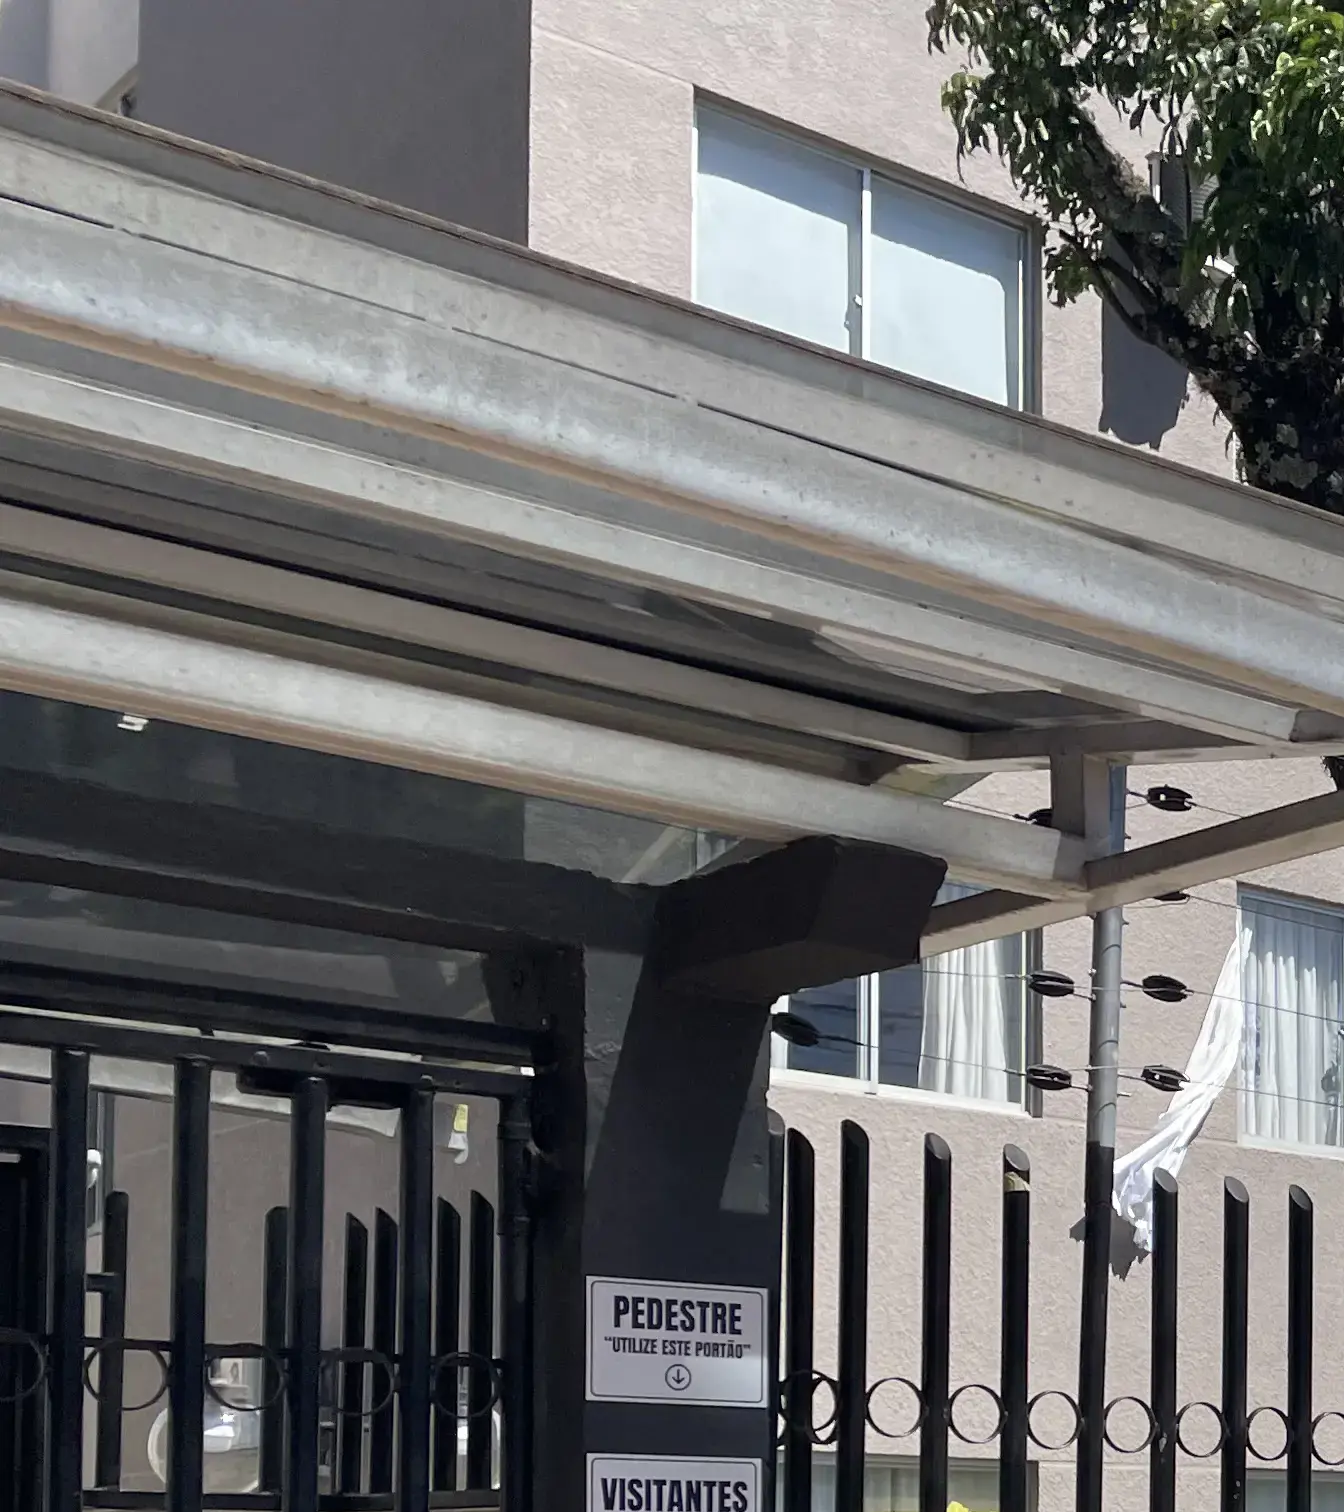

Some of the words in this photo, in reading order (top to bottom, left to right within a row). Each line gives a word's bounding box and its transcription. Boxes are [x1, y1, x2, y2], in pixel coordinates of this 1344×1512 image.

[613, 1295, 743, 1335] PEDESTRE
[661, 1340, 691, 1357] ESTE
[601, 1477, 748, 1512] VISITANTES
